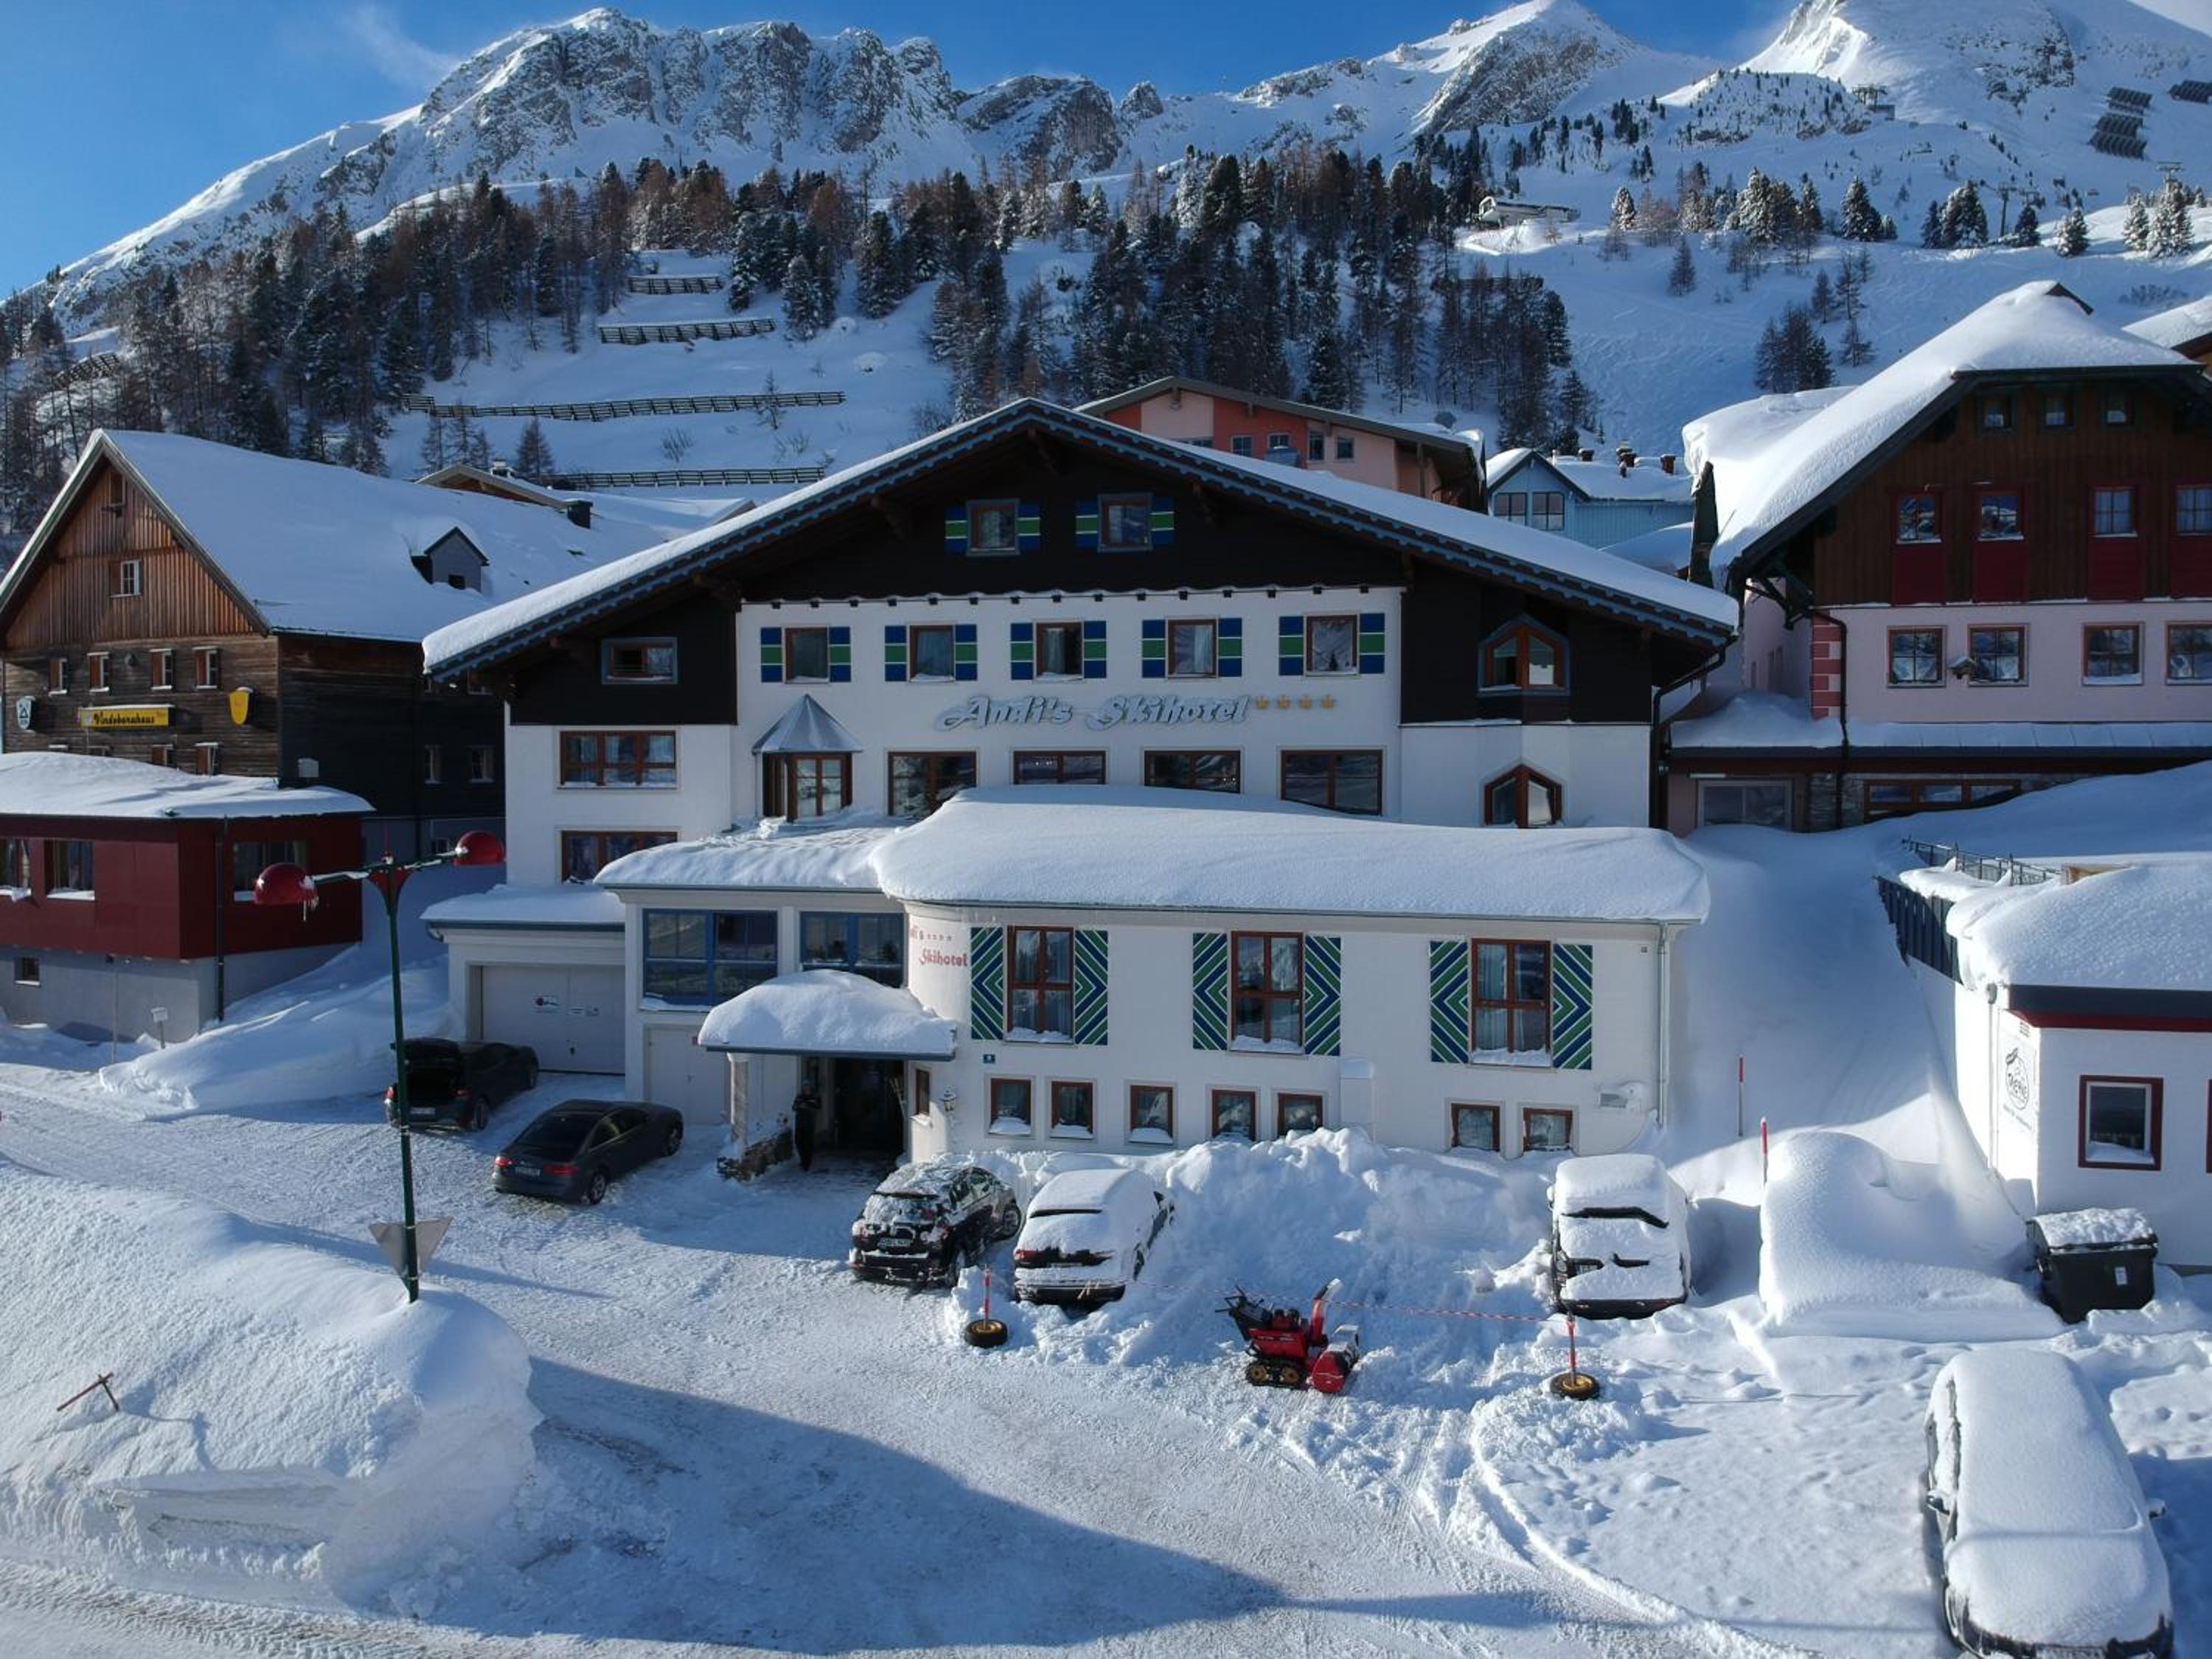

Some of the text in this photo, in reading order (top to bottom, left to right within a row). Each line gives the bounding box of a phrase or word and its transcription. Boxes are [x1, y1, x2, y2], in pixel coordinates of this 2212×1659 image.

[936, 695, 1251, 731] Andi's Skihotel
[919, 948, 967, 967] Skihotel
